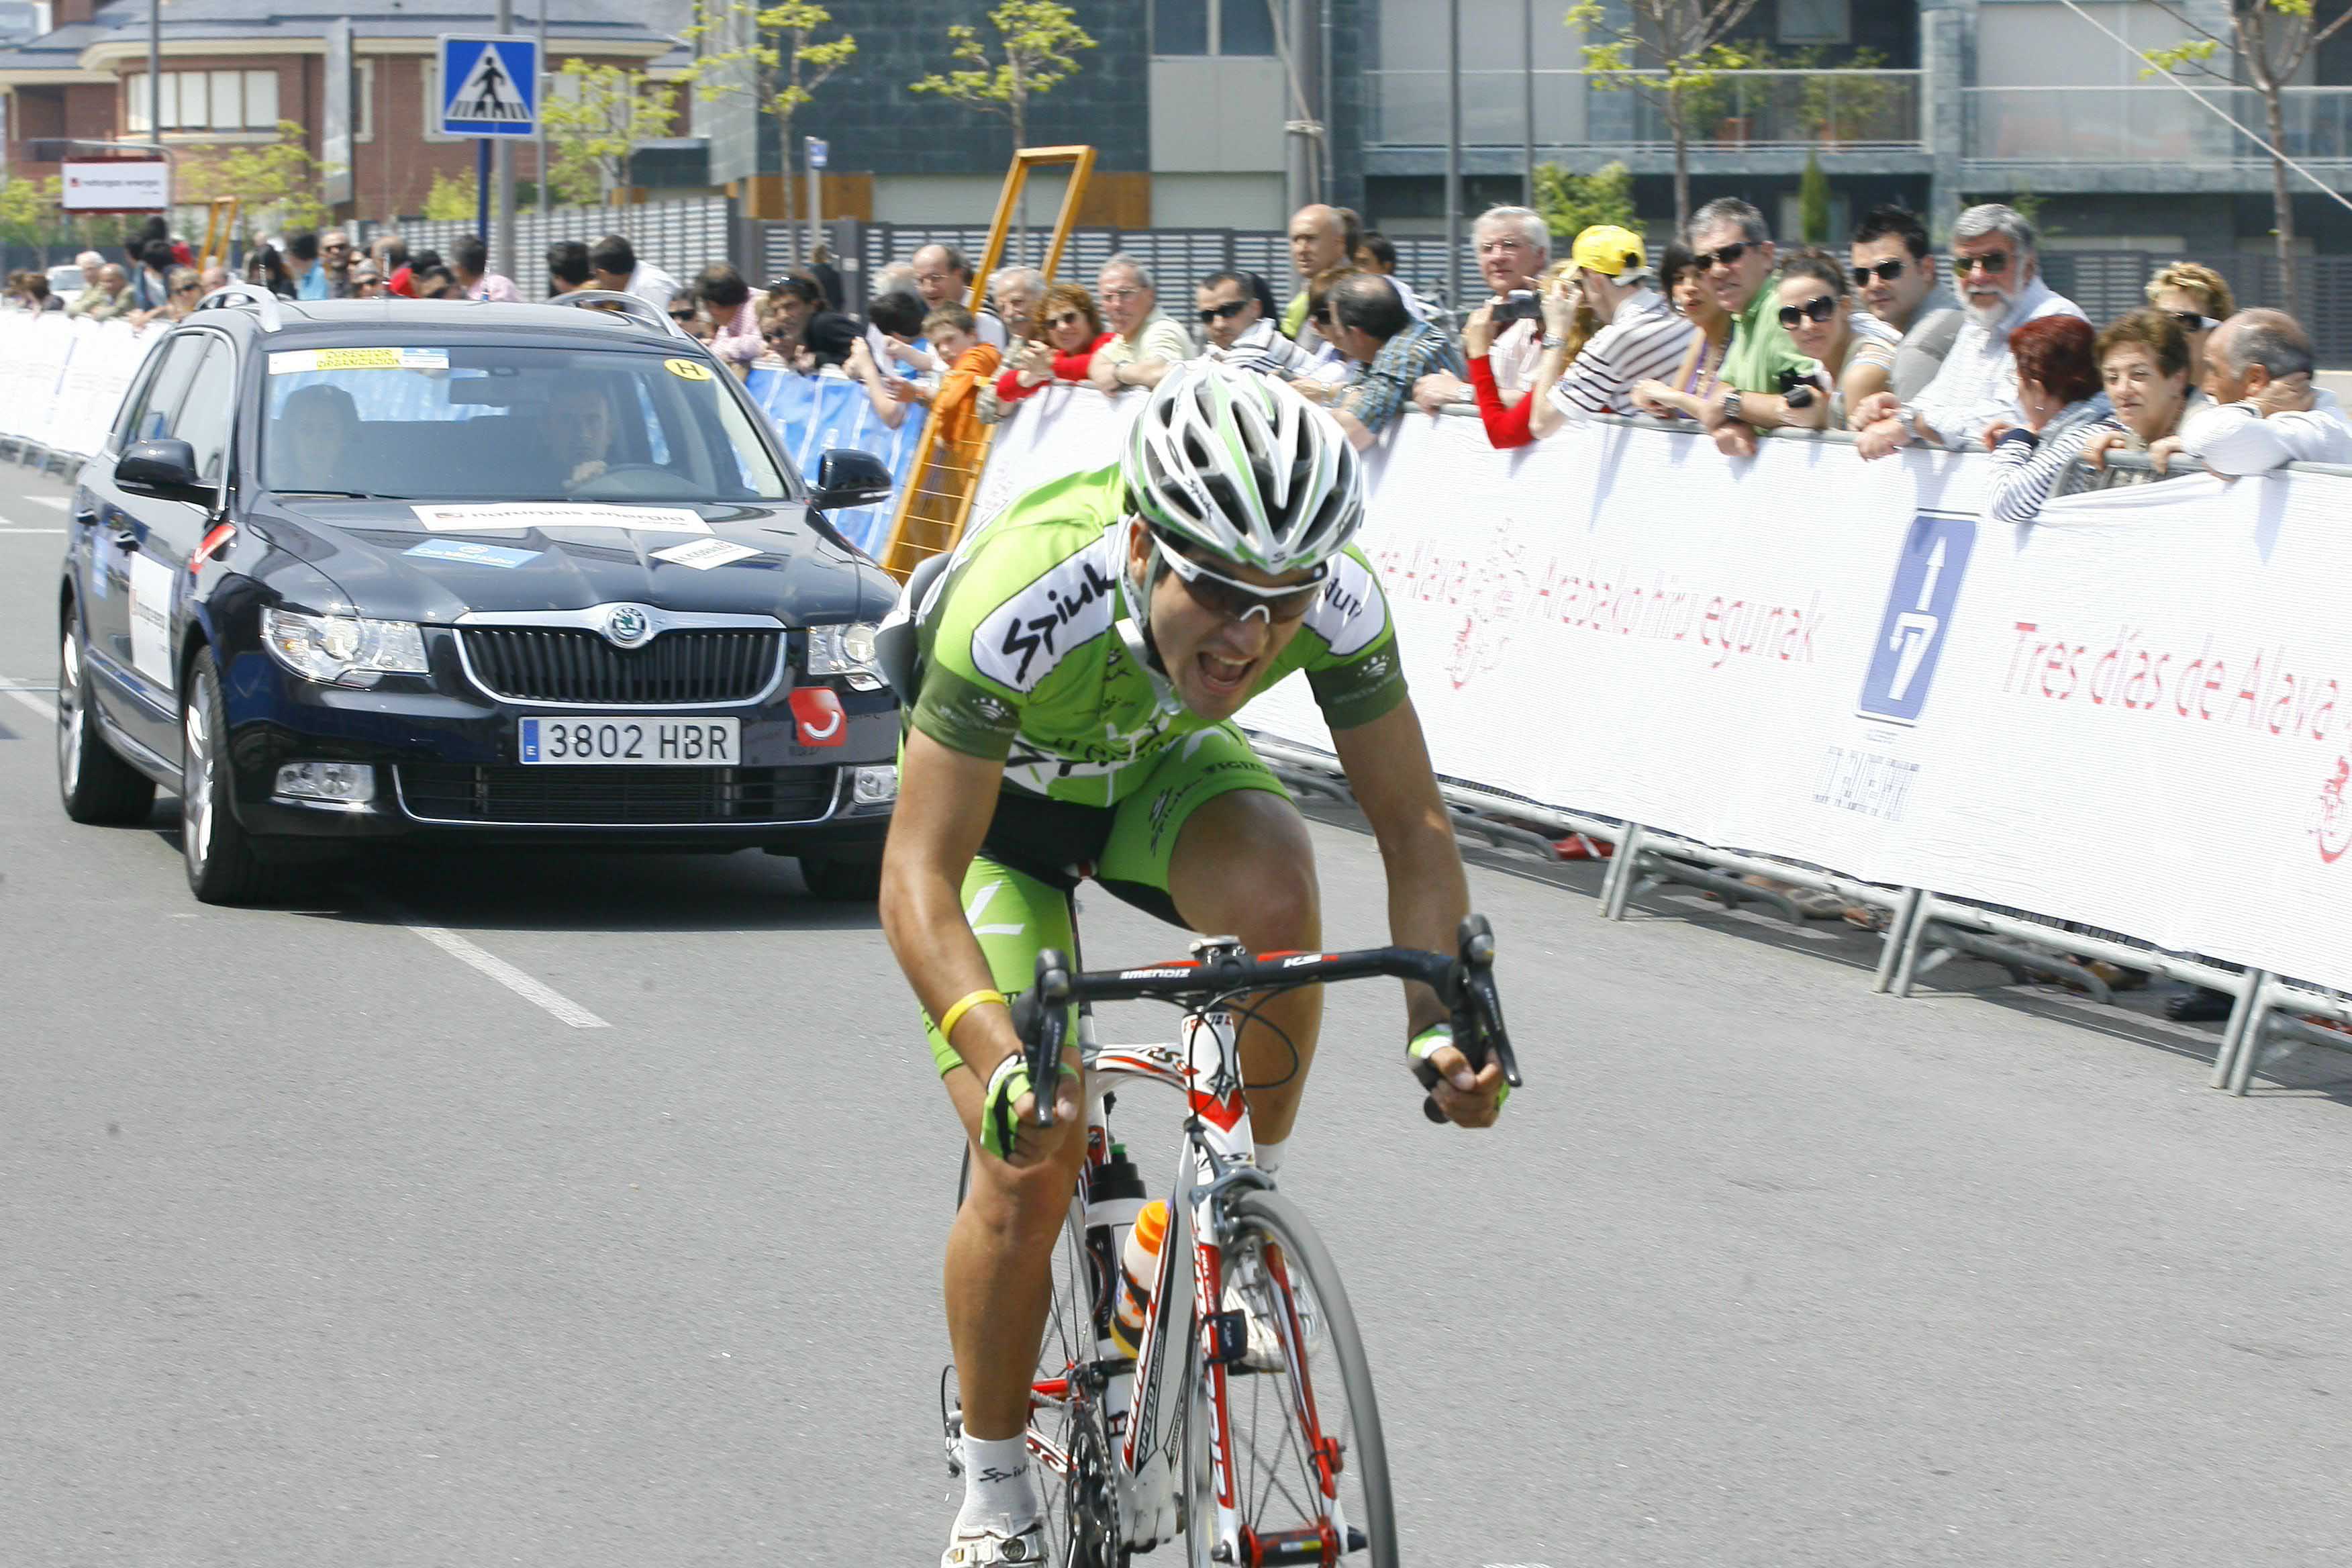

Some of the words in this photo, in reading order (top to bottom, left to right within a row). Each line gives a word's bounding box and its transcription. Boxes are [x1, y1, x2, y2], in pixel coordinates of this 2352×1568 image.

[675, 362, 703, 377] H
[1700, 589, 1825, 670] egunak
[2003, 621, 2086, 700] Tres
[2090, 624, 2171, 709] días
[2175, 632, 2226, 720] de
[549, 724, 644, 758] 3802
[659, 724, 727, 759] HBR
[1138, 1385, 1156, 1461] SPEED
[979, 1461, 1029, 1483] Spiu
